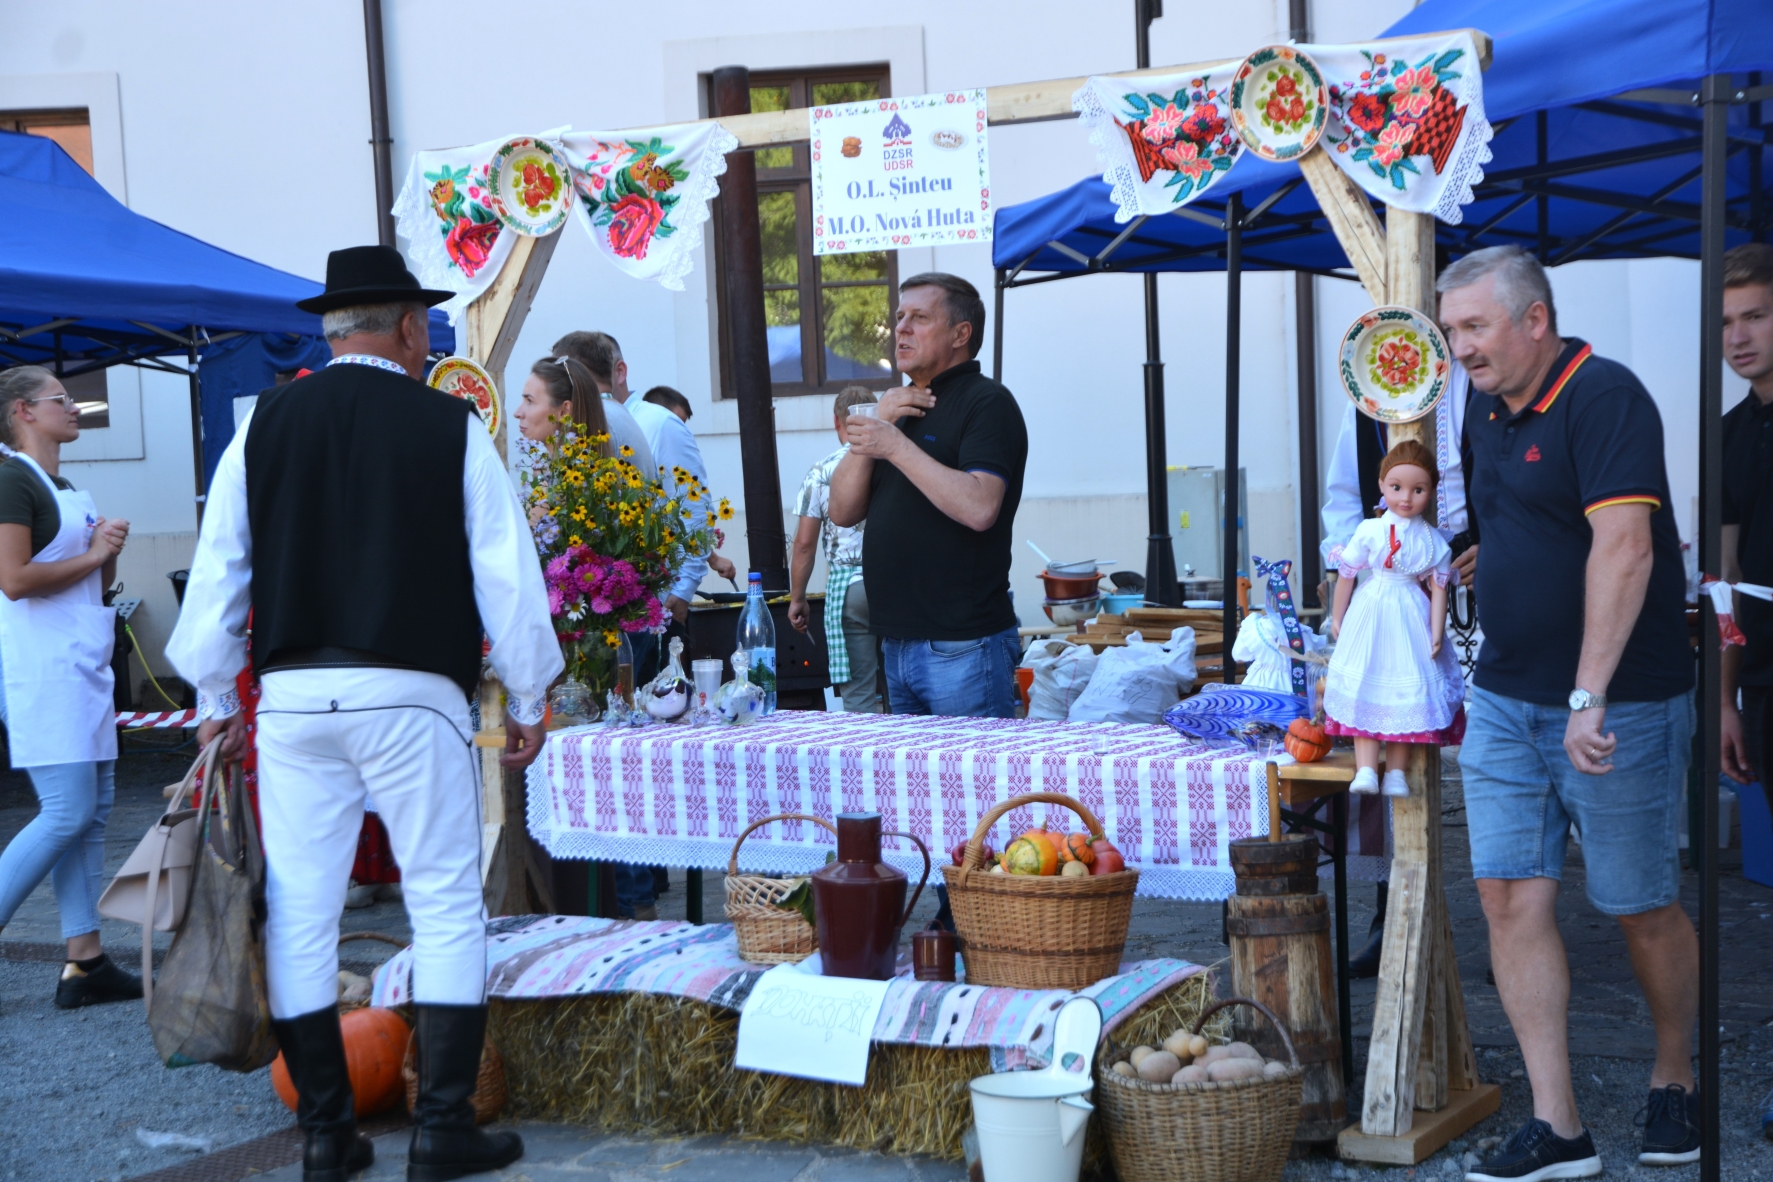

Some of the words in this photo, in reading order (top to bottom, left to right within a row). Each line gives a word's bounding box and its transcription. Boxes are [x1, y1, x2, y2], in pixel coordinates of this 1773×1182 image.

[883, 148, 913, 160] DZSR
[884, 159, 914, 171] UDSR
[847, 179, 885, 200] O.L.
[889, 175, 953, 202] Șinteu
[827, 214, 871, 236] M.O.
[875, 209, 923, 232] Nová
[927, 207, 976, 227] Huta
